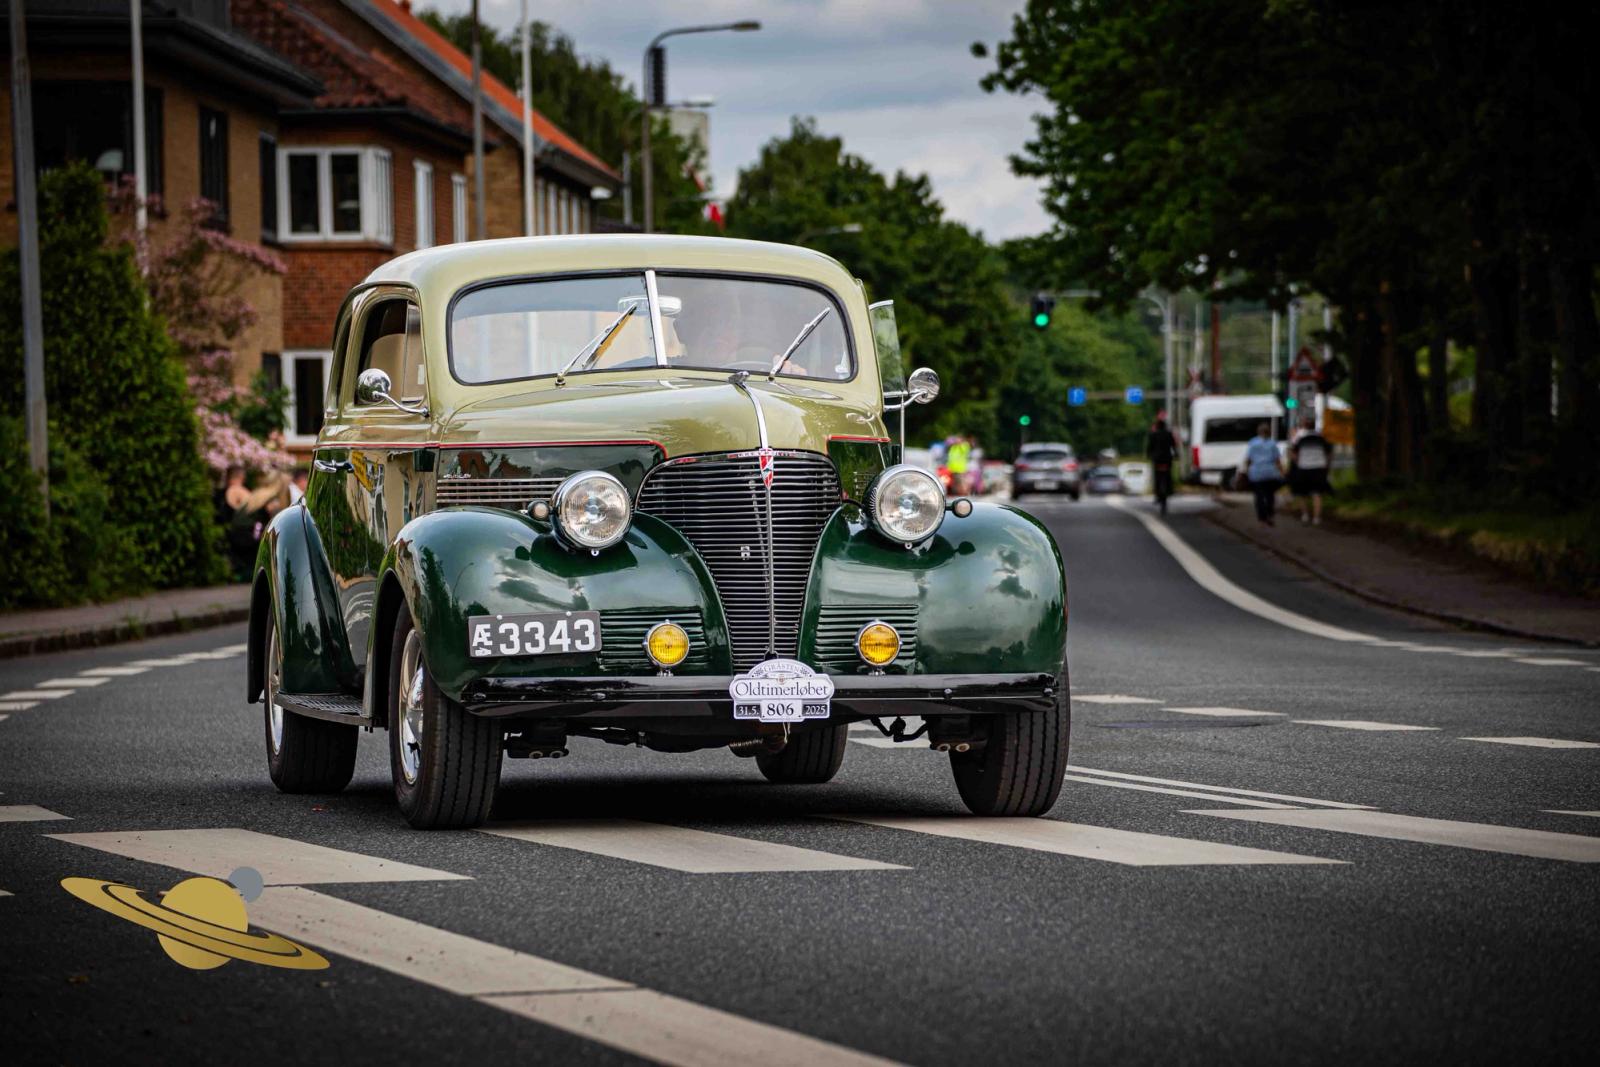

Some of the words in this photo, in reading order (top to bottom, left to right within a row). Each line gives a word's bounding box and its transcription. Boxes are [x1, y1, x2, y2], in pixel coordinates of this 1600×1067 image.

[498, 619, 596, 655] 3343
[735, 681, 829, 697] Oldtimerløbet
[766, 703, 794, 716] 806
[805, 705, 826, 715] 2025
